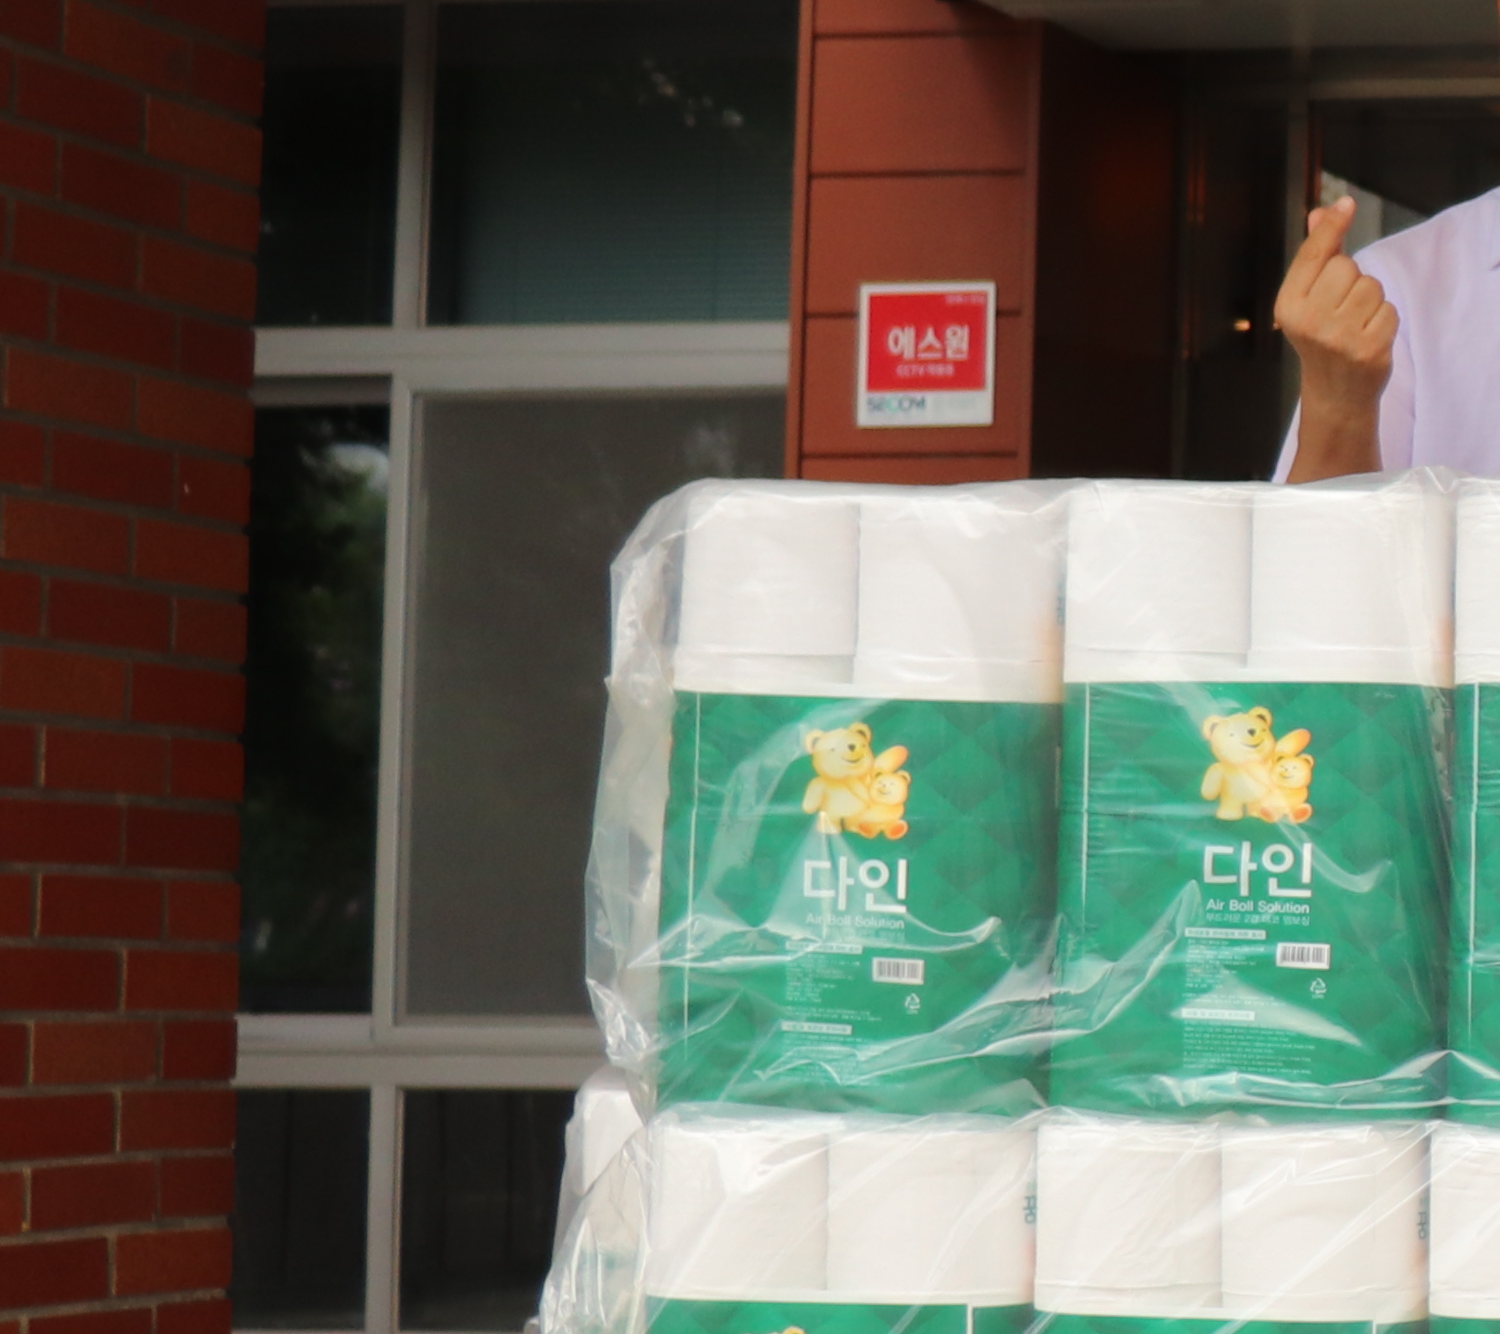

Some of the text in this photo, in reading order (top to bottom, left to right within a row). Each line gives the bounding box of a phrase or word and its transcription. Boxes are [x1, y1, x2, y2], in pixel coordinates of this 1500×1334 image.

[888, 324, 969, 360] 에스원
[803, 857, 908, 914] 다인
[1203, 841, 1312, 900] 다인
